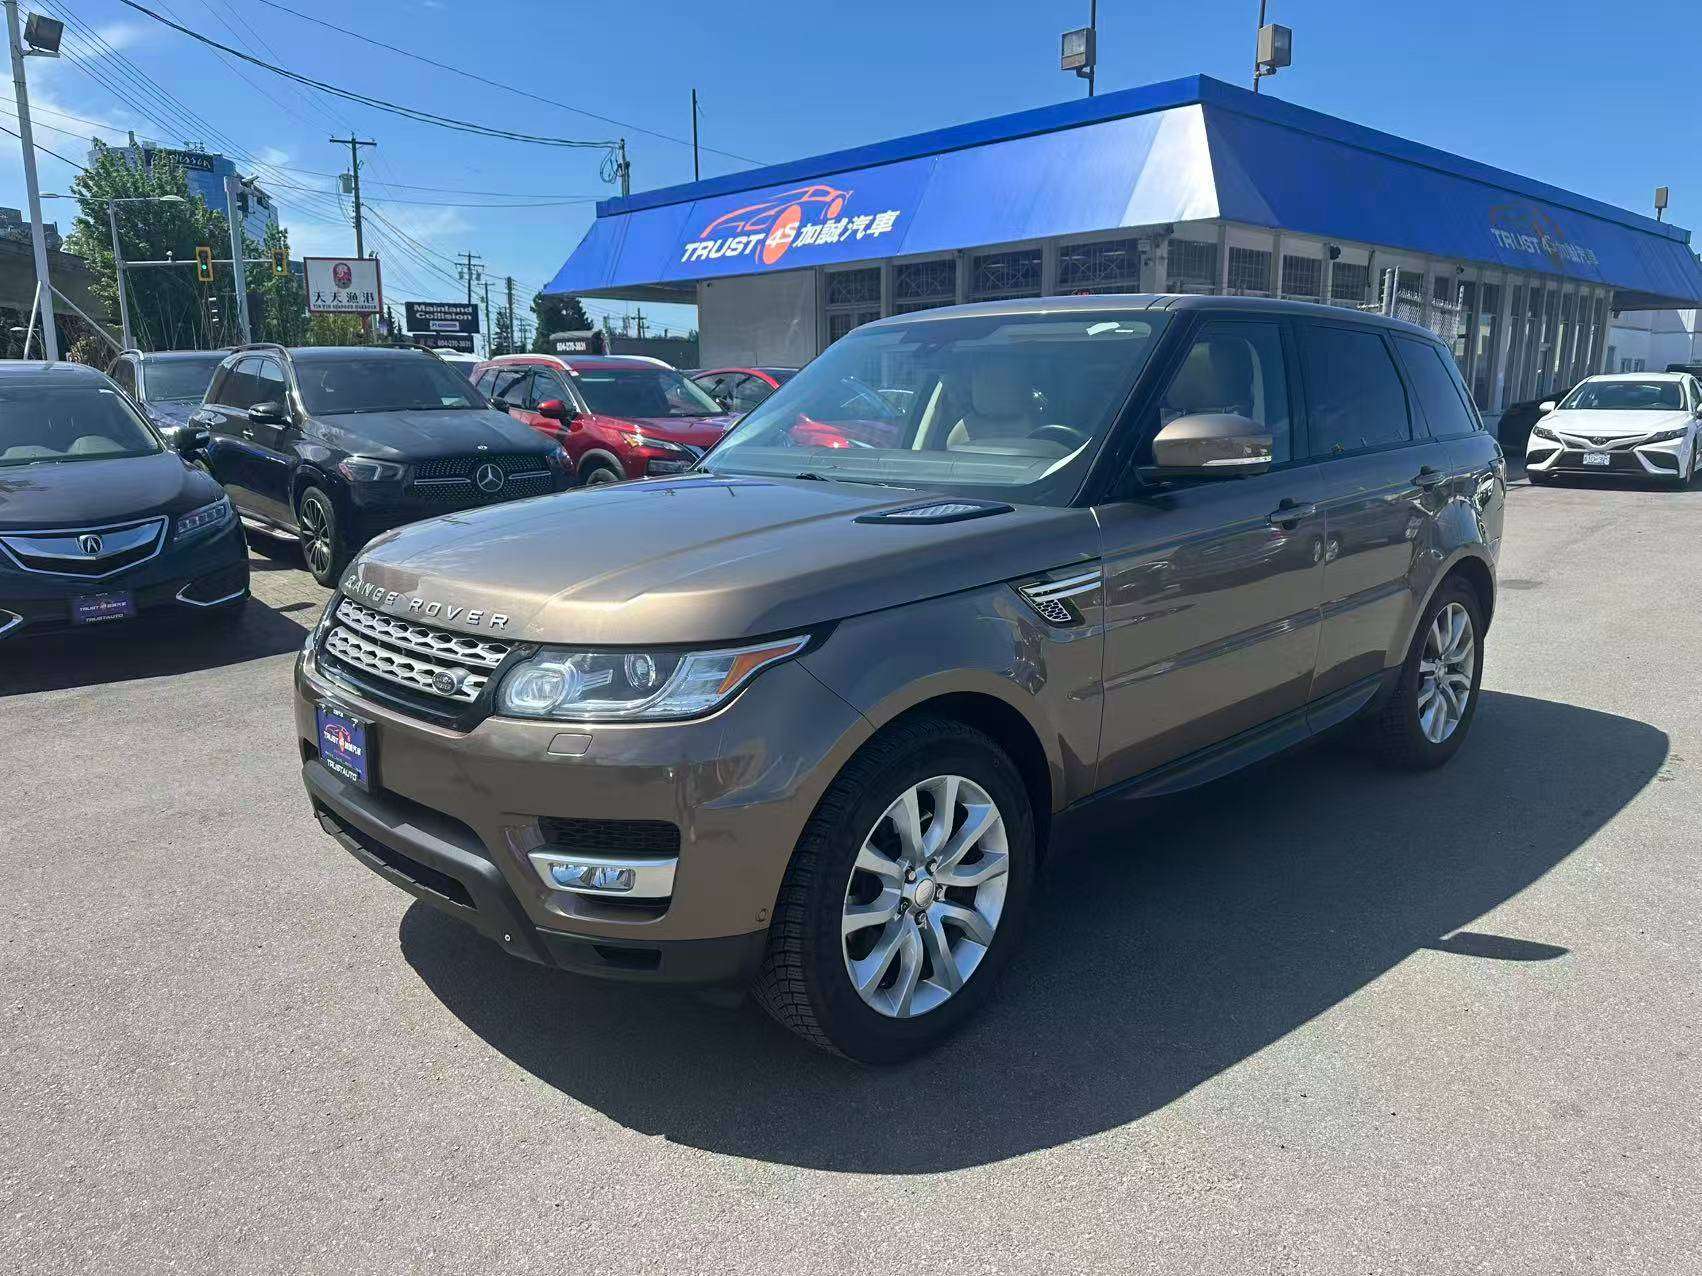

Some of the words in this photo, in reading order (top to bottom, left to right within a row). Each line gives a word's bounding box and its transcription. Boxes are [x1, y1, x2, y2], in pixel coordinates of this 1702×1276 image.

[681, 233, 766, 263] TRUST
[766, 221, 800, 248] 4S
[1490, 227, 1540, 255] TRUST
[413, 304, 473, 313] Mainland
[415, 312, 472, 320] Collision
[345, 575, 399, 606] RANGE
[408, 598, 510, 630] ROVER
